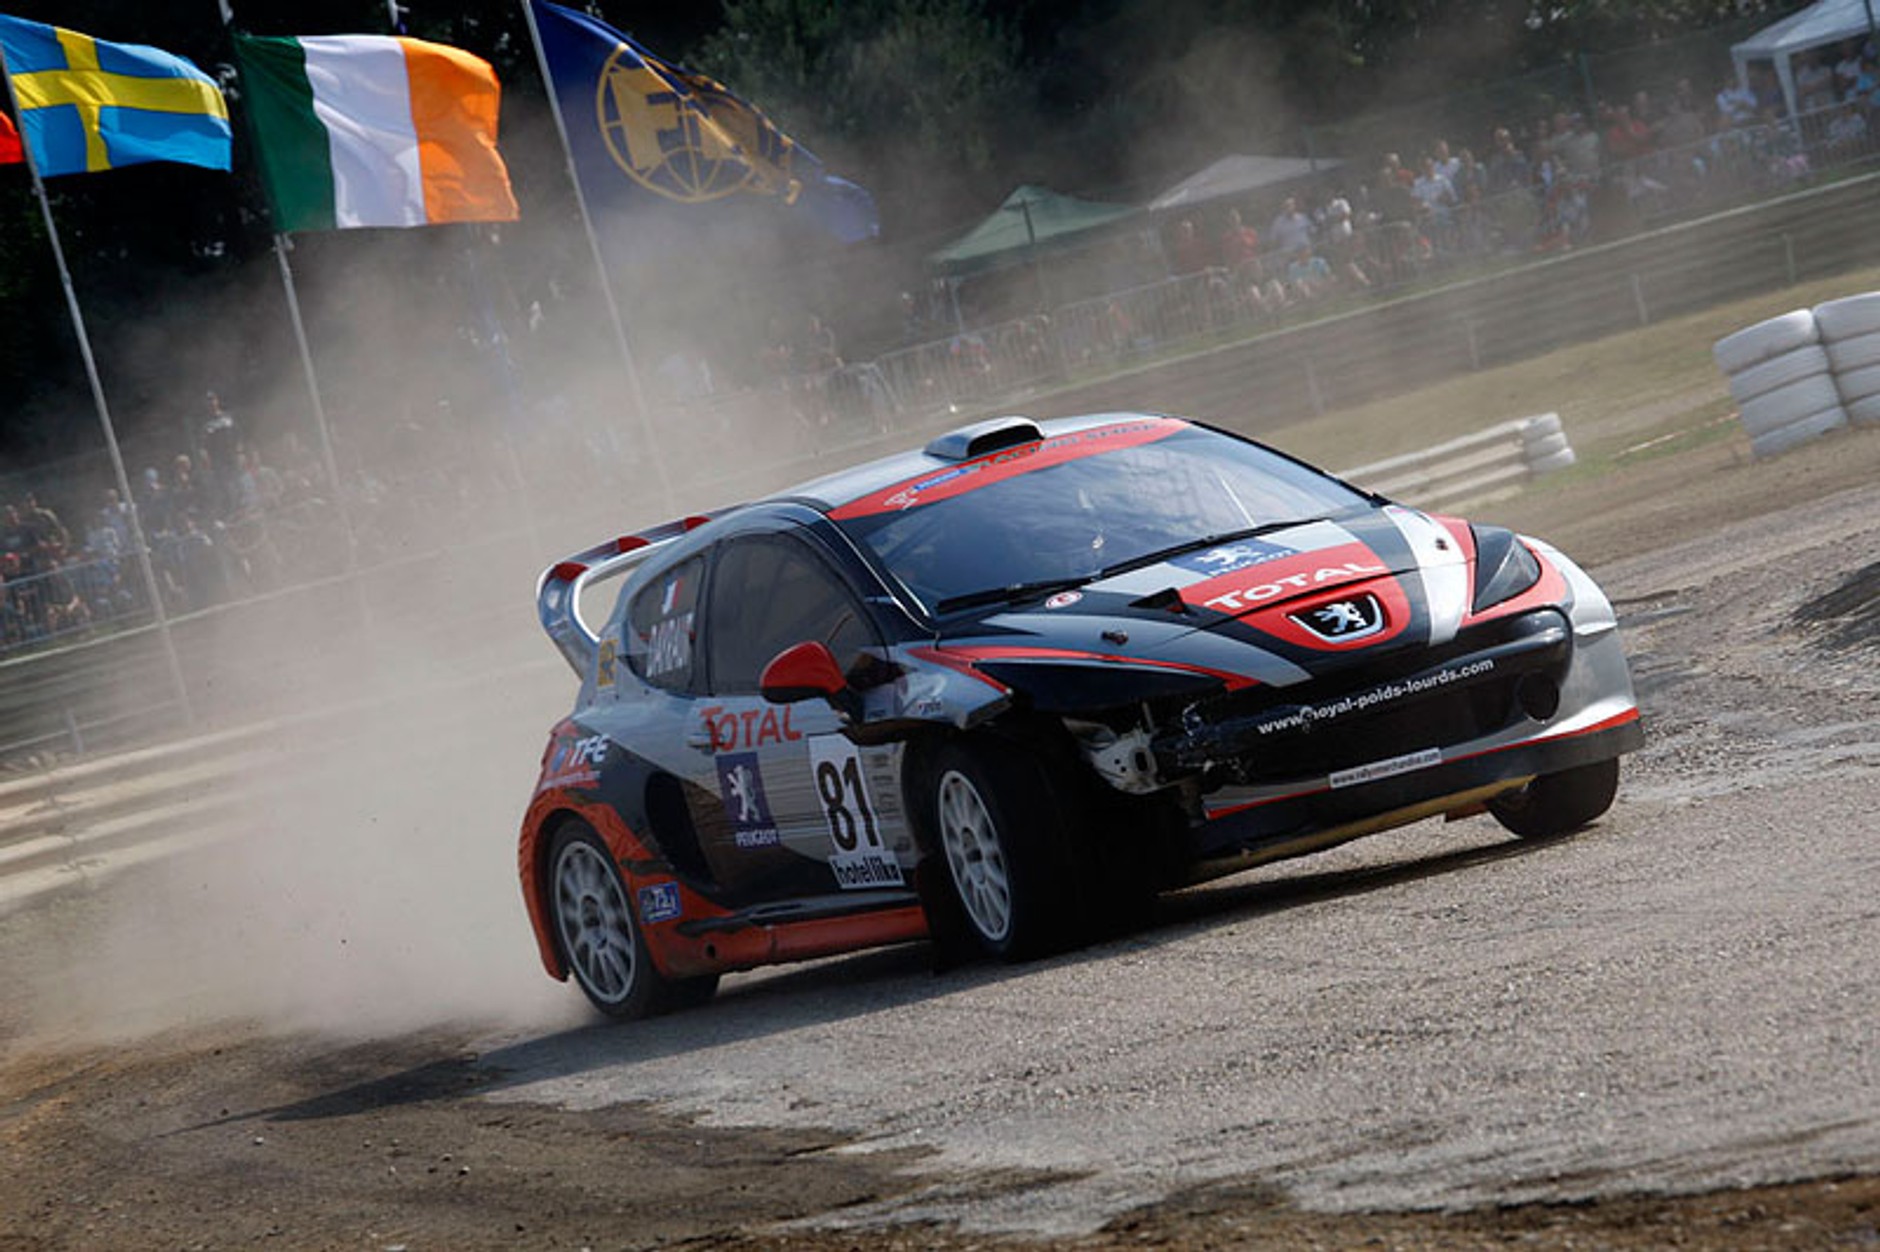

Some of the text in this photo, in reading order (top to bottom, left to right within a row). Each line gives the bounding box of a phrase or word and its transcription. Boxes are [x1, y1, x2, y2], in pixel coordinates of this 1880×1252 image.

[1202, 562, 1386, 610] TOTAL
[1257, 658, 1494, 735] wwwroyal-poids-lourds.com
[700, 704, 803, 752] TOTAL
[817, 756, 879, 851] 81
